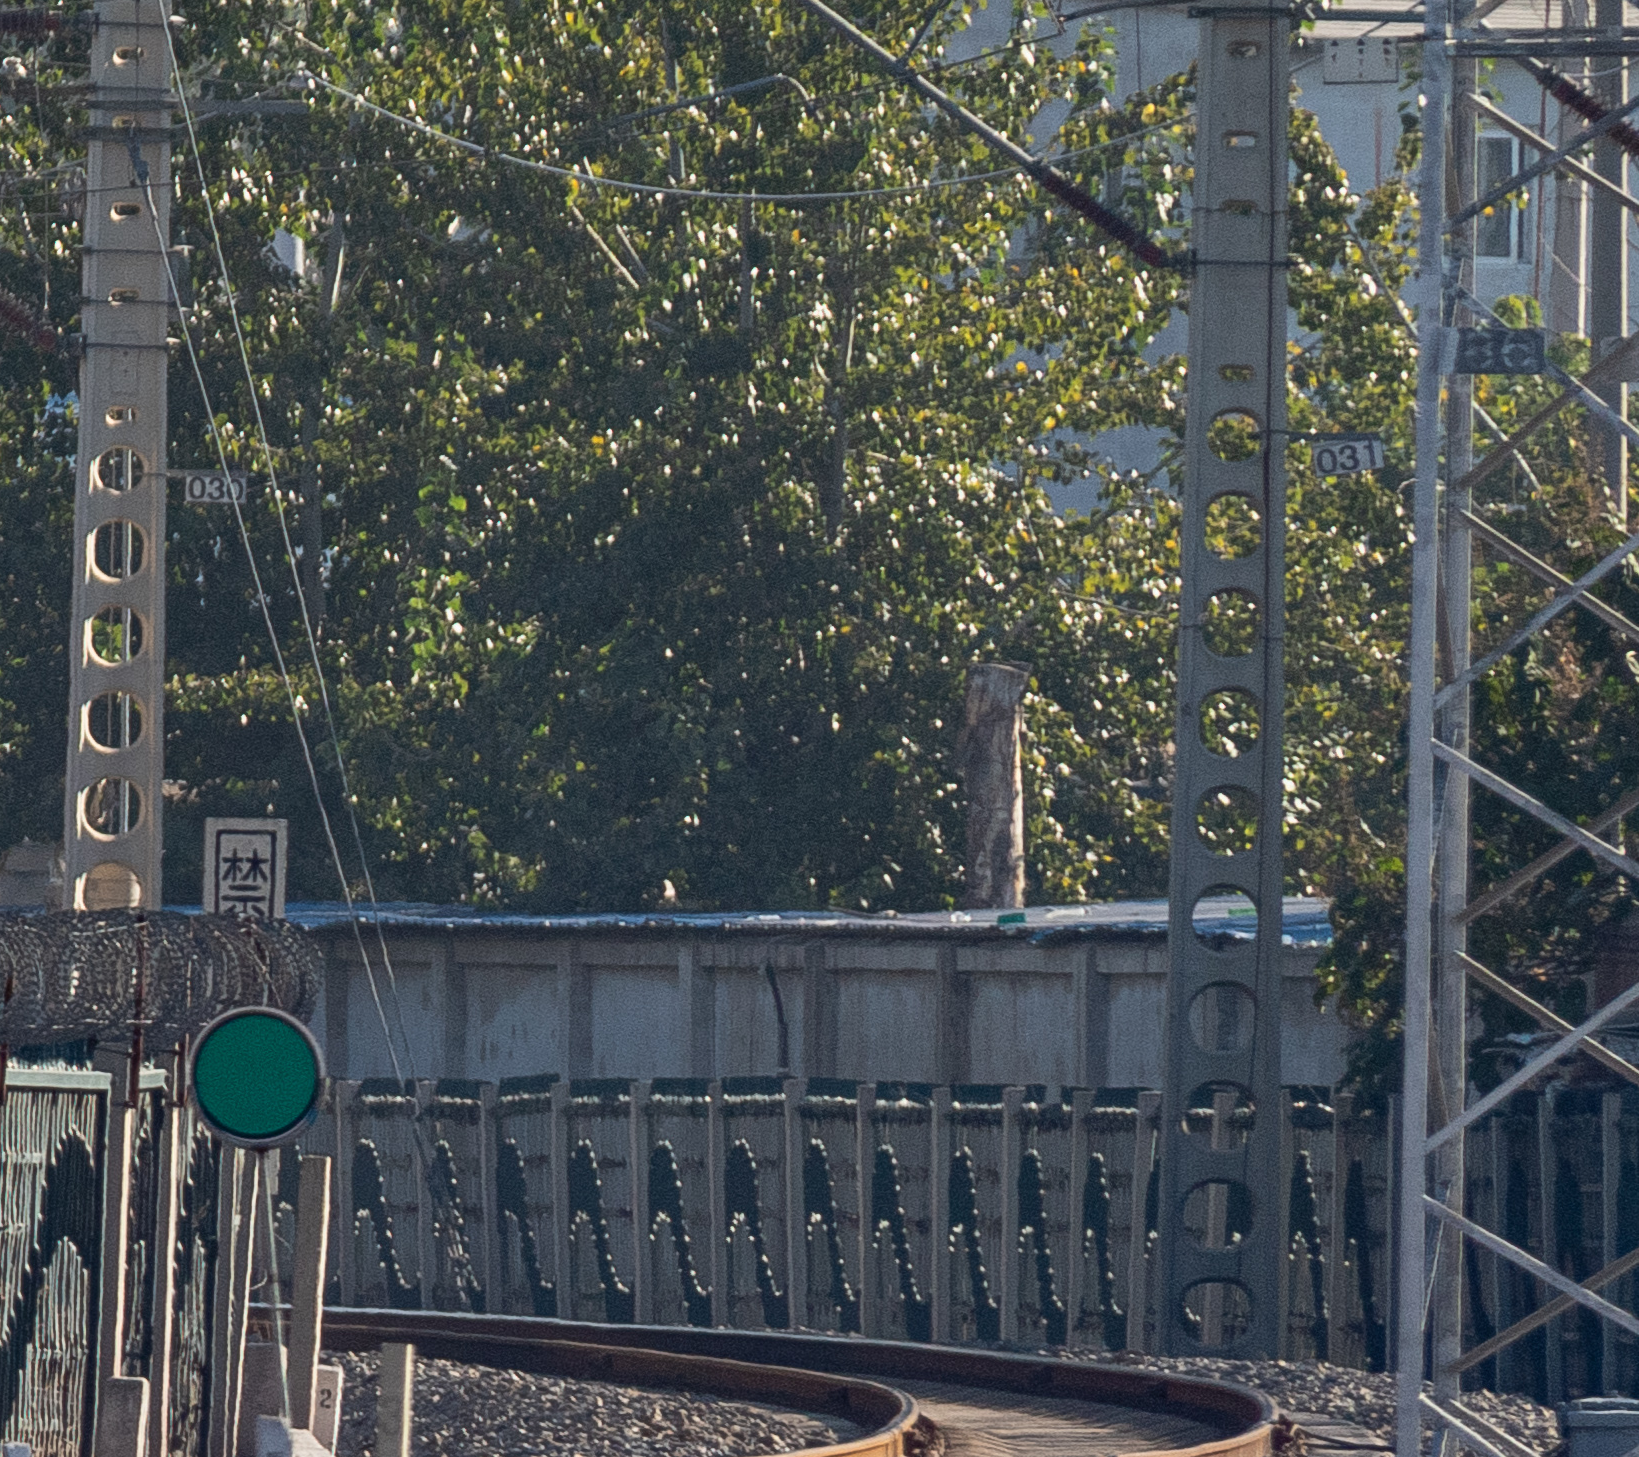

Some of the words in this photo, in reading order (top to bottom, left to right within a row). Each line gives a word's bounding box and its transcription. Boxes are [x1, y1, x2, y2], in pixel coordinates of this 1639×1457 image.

[1317, 439, 1376, 475] 031
[189, 476, 244, 501] 030
[222, 847, 270, 917] 禁
[320, 1389, 332, 1409] 2
